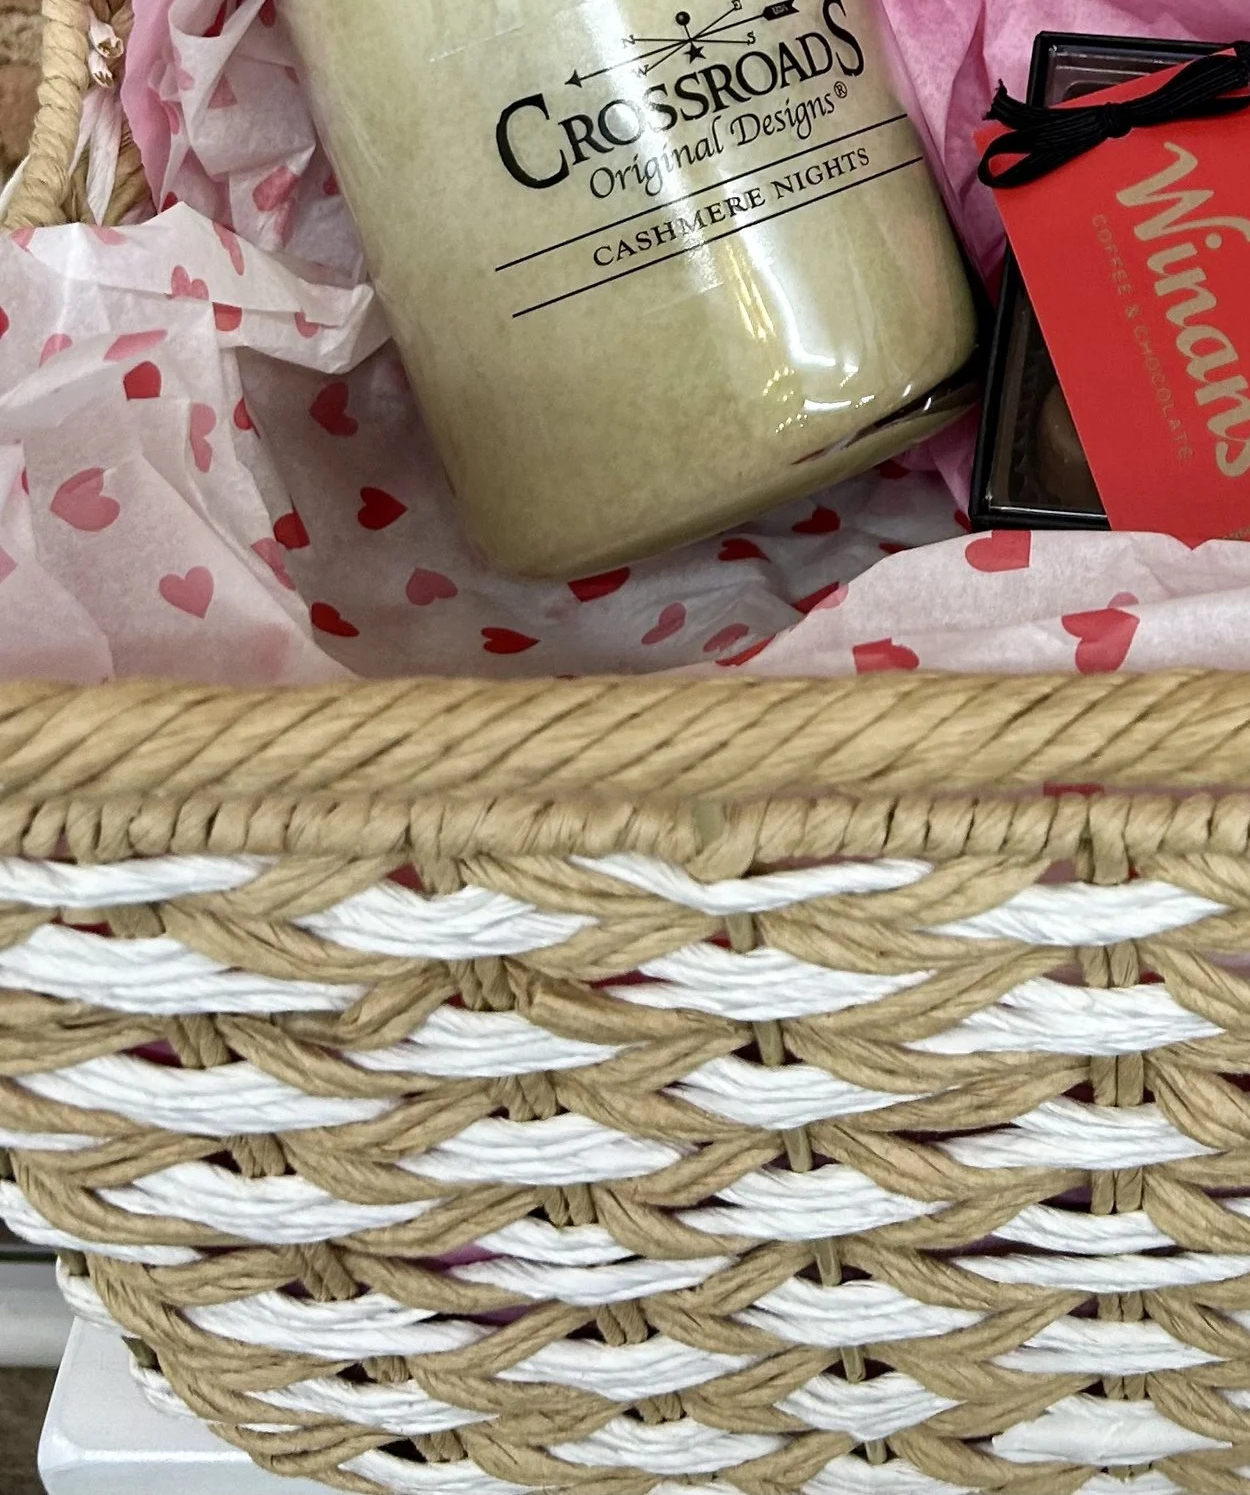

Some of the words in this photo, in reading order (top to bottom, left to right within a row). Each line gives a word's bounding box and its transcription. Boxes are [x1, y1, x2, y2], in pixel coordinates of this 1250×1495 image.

[590, 115, 724, 199] Original
[593, 187, 766, 267] CASHMERE
[776, 148, 870, 199] NIGHTS
[1092, 214, 1135, 296] COFFEE
[1133, 325, 1194, 460] CHOCOLATE
